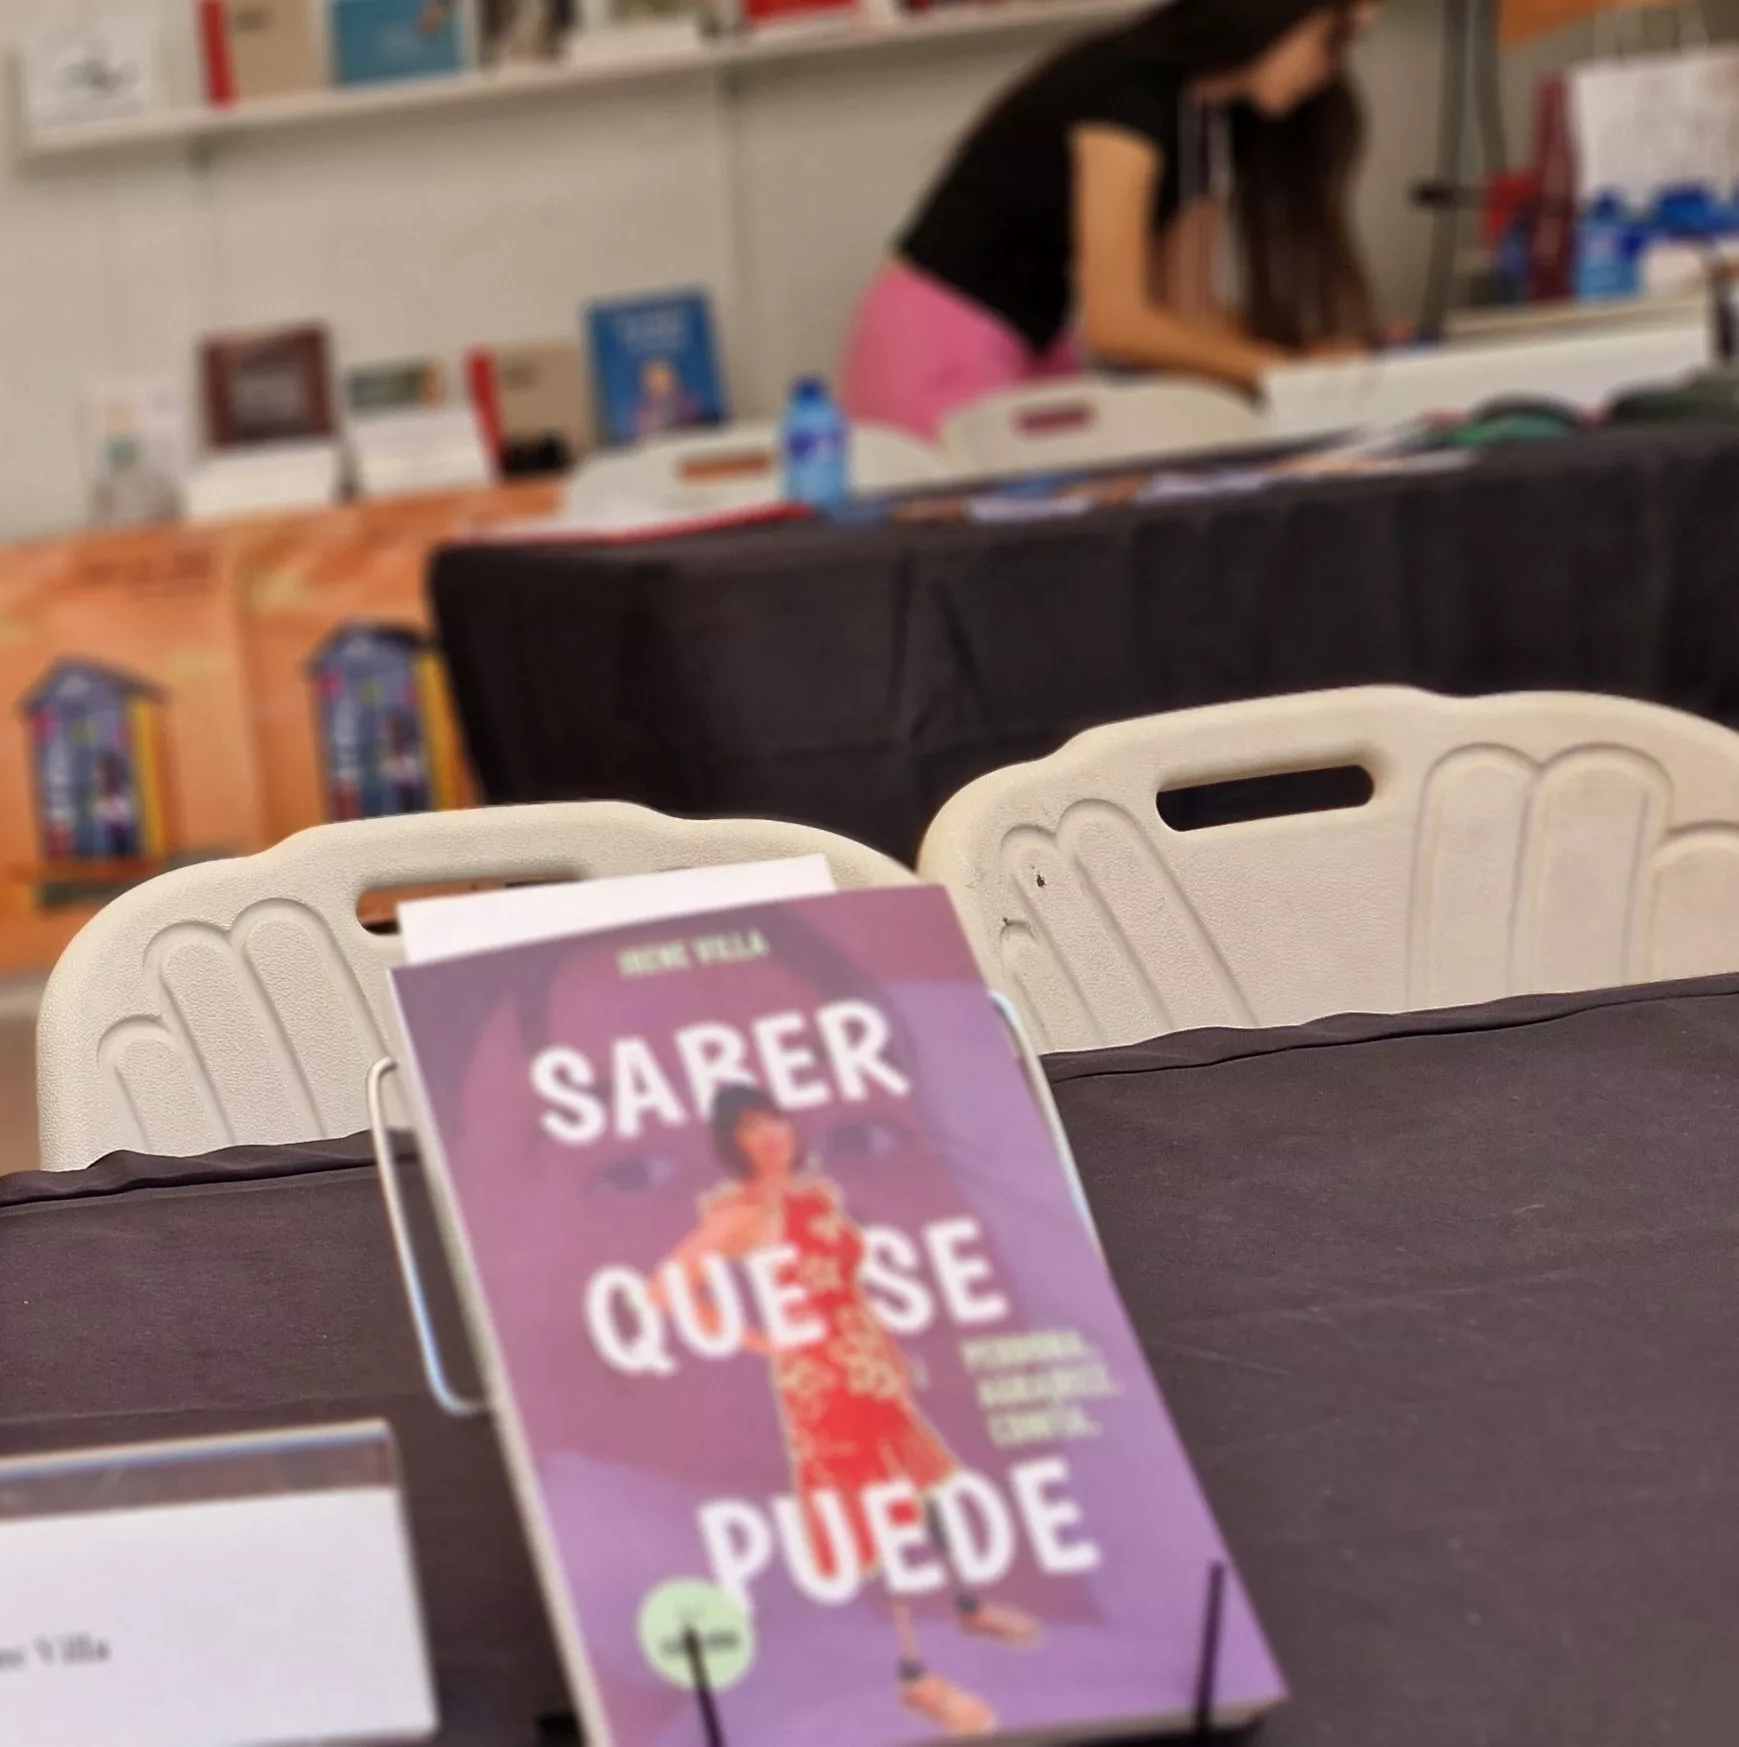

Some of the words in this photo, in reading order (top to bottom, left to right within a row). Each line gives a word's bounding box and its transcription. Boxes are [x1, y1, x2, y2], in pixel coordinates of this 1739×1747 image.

[529, 997, 911, 1146] SABER
[583, 1243, 830, 1377] QUE
[860, 1217, 1012, 1334] SE
[697, 1455, 1102, 1612] PUEDE
[32, 1631, 113, 1667] Villa
